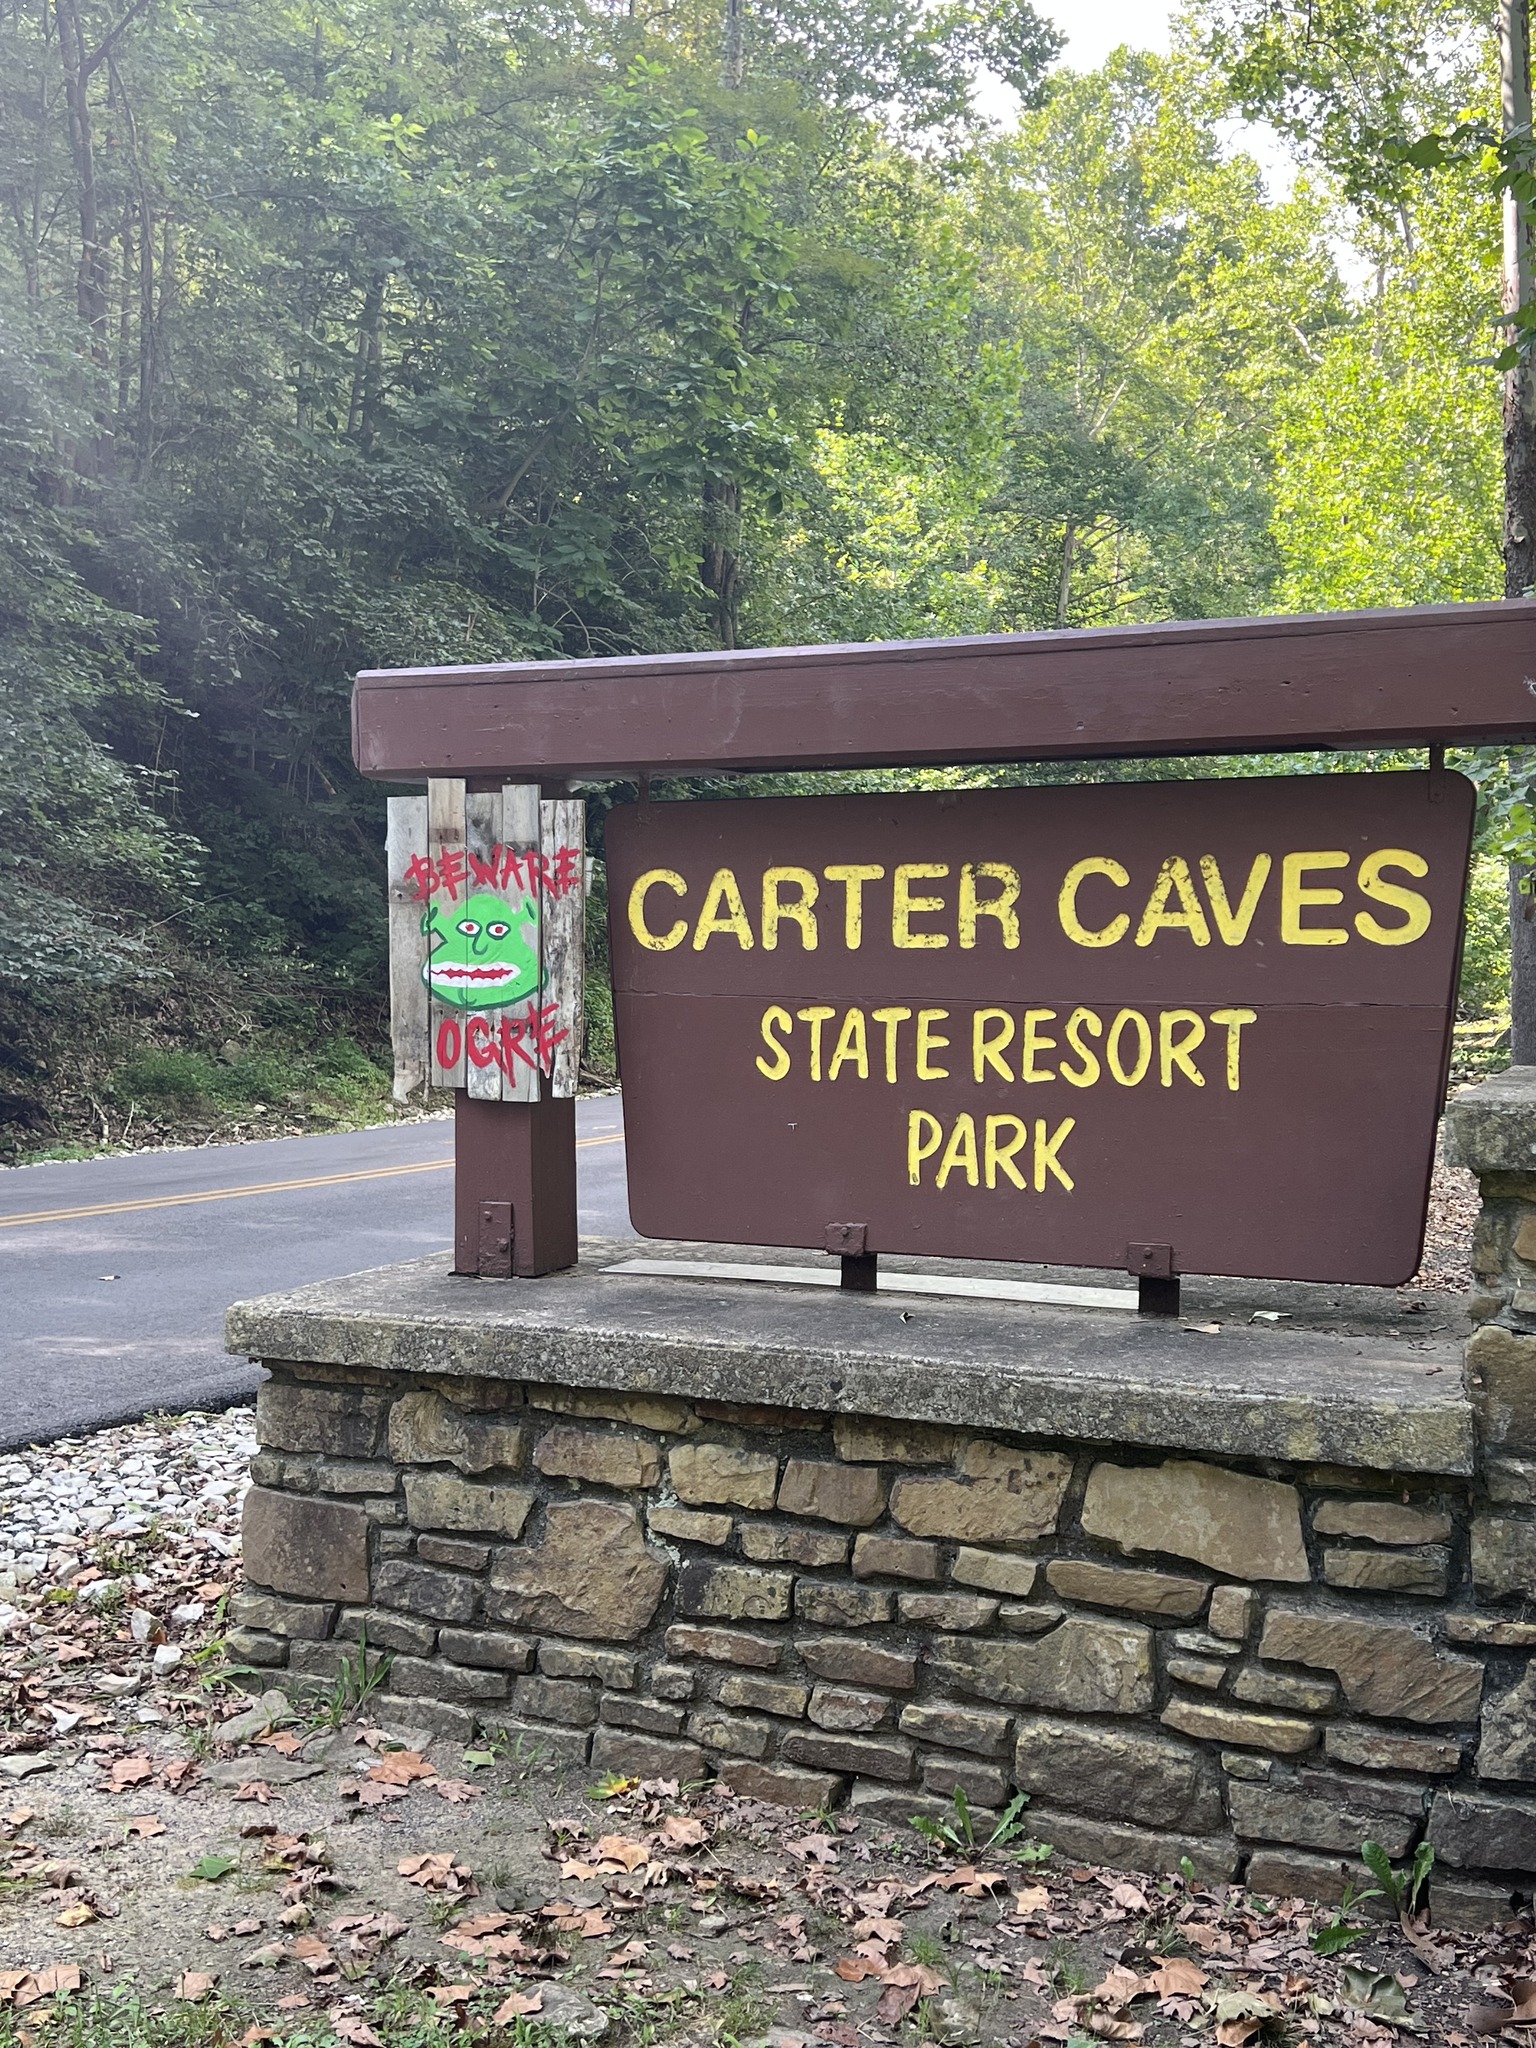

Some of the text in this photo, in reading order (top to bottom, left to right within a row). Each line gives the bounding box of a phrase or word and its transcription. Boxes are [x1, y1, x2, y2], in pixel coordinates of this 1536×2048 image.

[404, 843, 581, 905] BEWARE
[628, 848, 1432, 951] CARTER CAVES
[436, 1001, 569, 1088] OGRE
[755, 1005, 1258, 1091] STATE RESORT
[909, 1109, 1076, 1193] PARK
